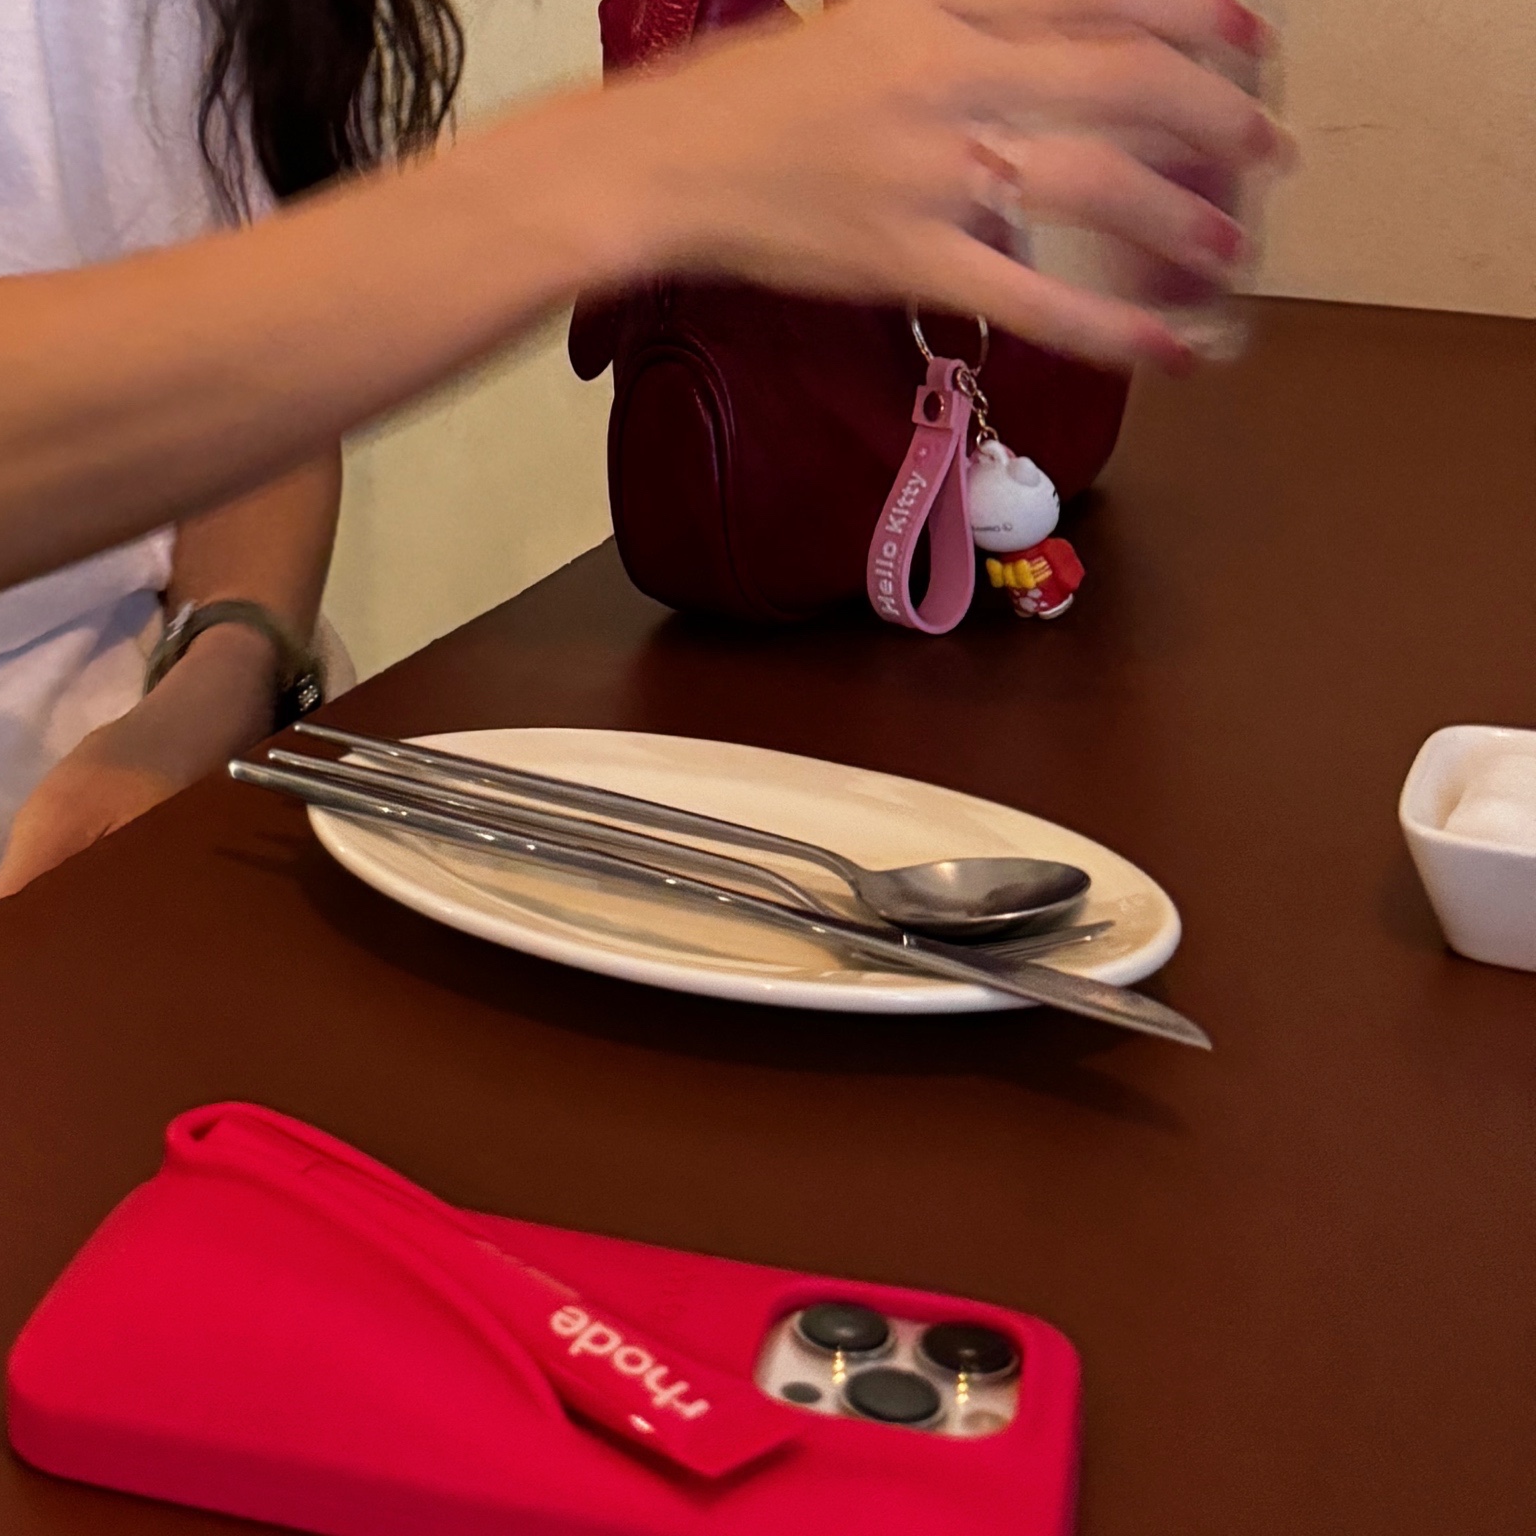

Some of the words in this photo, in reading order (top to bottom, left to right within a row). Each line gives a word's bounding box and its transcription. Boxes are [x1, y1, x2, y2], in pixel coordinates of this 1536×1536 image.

[884, 471, 927, 534] Kitty
[874, 541, 899, 616] Hello
[550, 1305, 710, 1419] rhode
